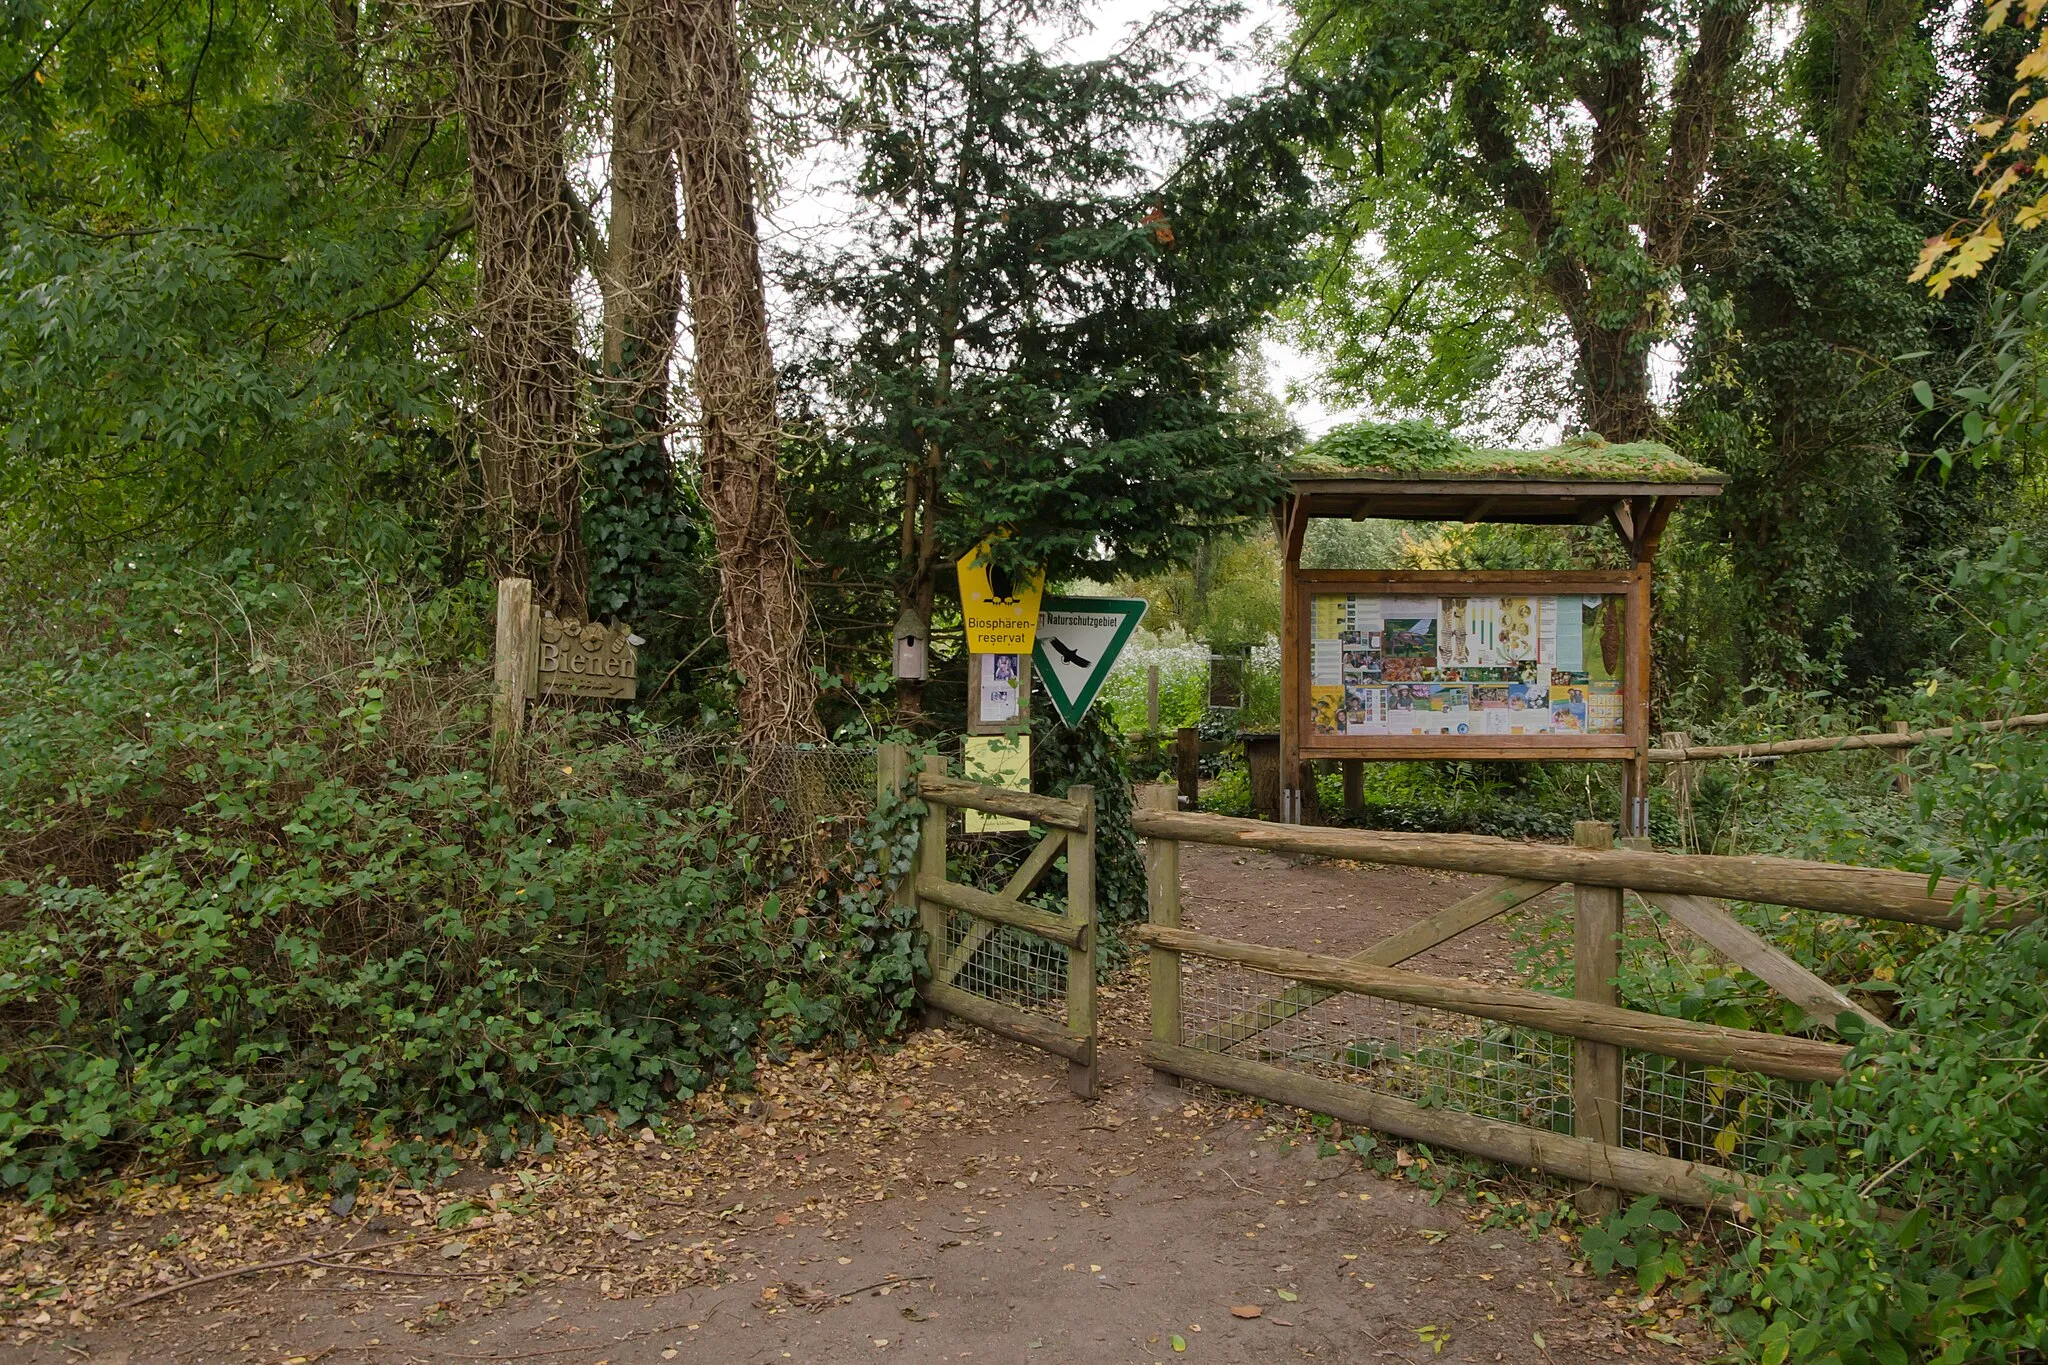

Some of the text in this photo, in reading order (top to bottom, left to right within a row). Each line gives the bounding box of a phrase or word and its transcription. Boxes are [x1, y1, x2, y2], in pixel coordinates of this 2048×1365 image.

[968, 617, 1035, 630] Biosphären-
[1047, 614, 1117, 628] Naturschutzgebiet
[978, 633, 1025, 643] reservat
[539, 643, 636, 679] Bienen
